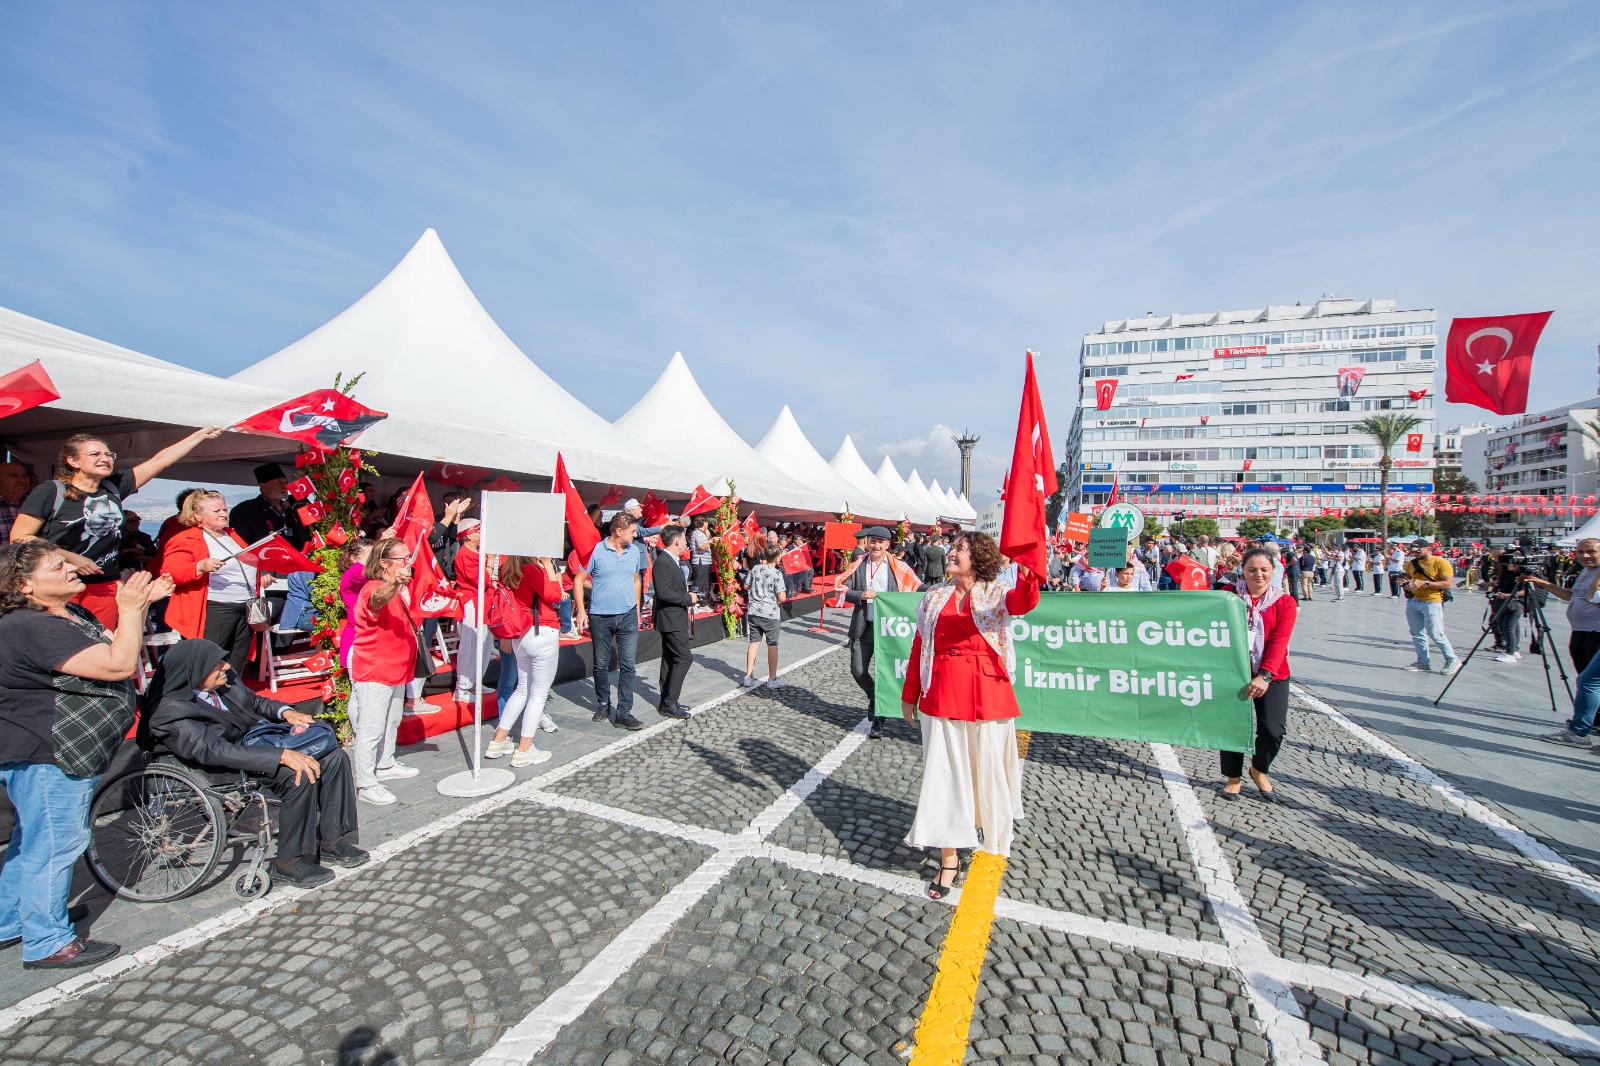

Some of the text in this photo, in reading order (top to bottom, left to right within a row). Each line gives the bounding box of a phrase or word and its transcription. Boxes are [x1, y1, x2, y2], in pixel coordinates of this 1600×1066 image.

[1011, 615, 1231, 650] Örgütlü Gücü
[1024, 657, 1213, 707] İzmir Birliği
